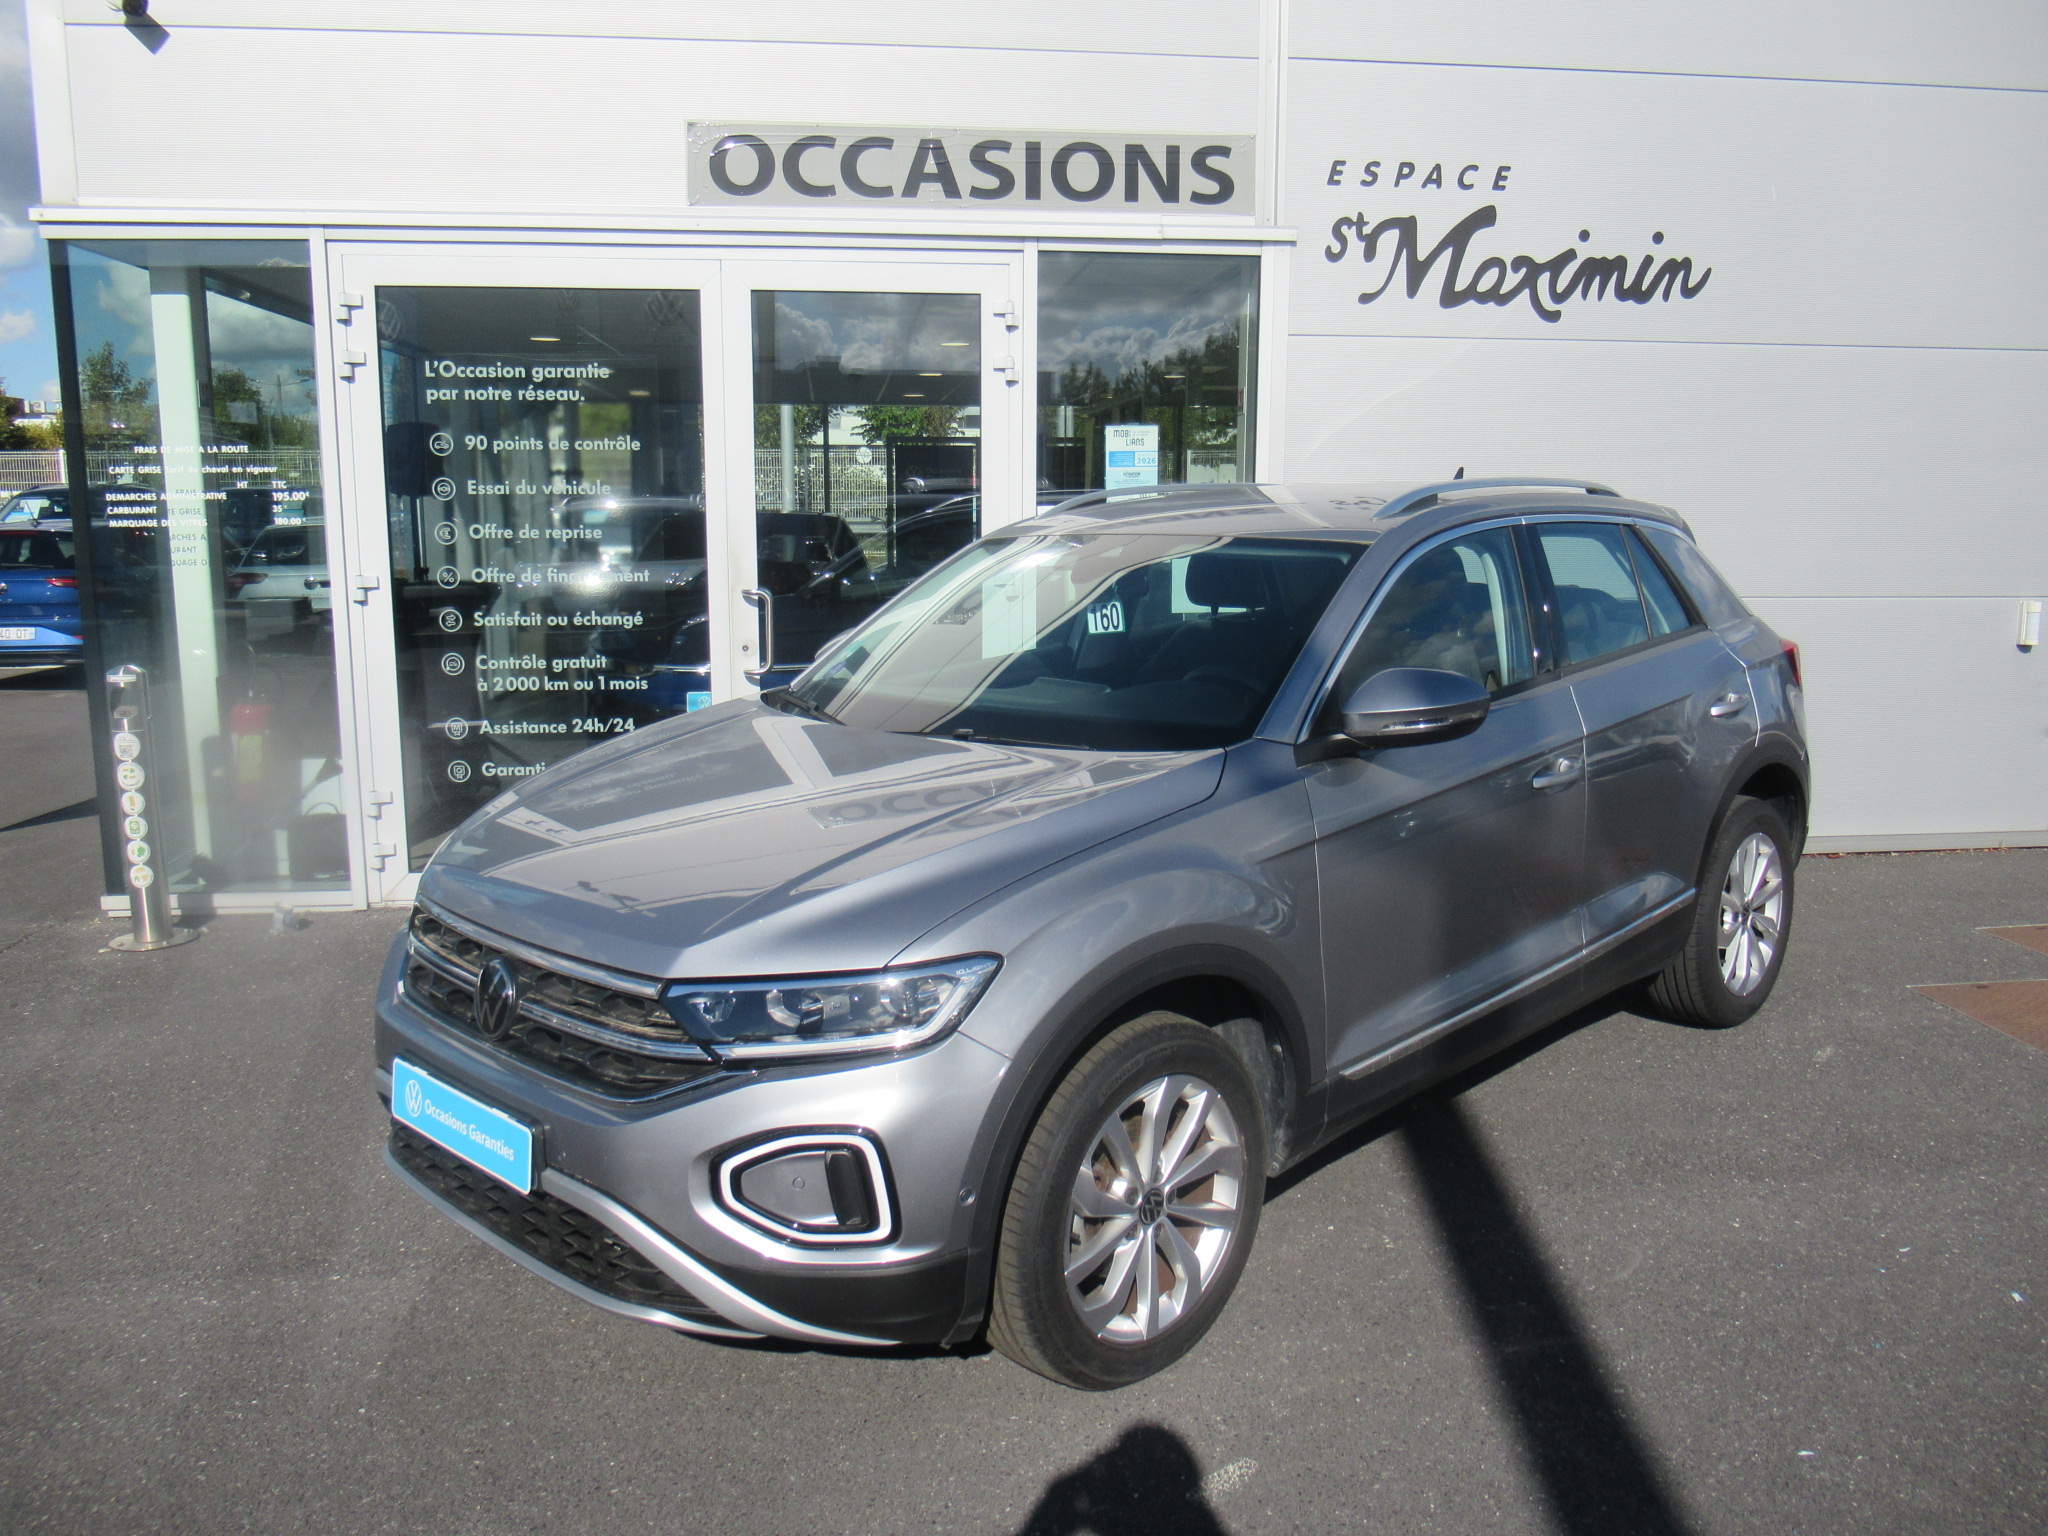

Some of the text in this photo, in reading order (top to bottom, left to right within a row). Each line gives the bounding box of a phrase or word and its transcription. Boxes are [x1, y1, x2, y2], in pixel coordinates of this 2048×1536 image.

[709, 133, 1236, 206] OCCASIONS
[1326, 159, 1512, 192] ESPACE
[1324, 204, 1712, 324] St Maximin
[531, 362, 610, 382] garantie
[426, 384, 585, 404] par notre réseau.
[134, 445, 250, 454] FRAIS DE MISE A LA ROUTE
[464, 435, 641, 454] 90 points de contrôle
[108, 465, 135, 475] CARTE
[137, 465, 162, 474] GRISE
[201, 464, 229, 473] cheval
[246, 464, 278, 475] vigueur
[1136, 457, 1157, 465] 2026
[237, 480, 287, 489] HT TTC
[467, 480, 510, 496] Essai
[515, 480, 537, 495] du
[105, 492, 157, 502] DEMARCHES
[160, 491, 227, 501] ADMINISTRATIVE
[107, 506, 157, 515] CARBURANT
[109, 519, 159, 528] MARQUAGE
[161, 519, 177, 528] DES
[180, 518, 208, 527] VITRES
[469, 523, 602, 542] Offre de reprise
[471, 567, 515, 584] Offre
[521, 567, 542, 583] de
[473, 610, 643, 629] Satisfait ou échangé
[1091, 603, 1120, 631] 160
[475, 654, 607, 673] Contrôle gratuit
[477, 677, 488, 691] à
[544, 676, 569, 691] km
[573, 680, 594, 691] ou
[598, 676, 605, 690] 1
[610, 676, 648, 691] mois
[479, 718, 635, 735] Assistance 24h/24
[425, 1099, 468, 1136] Occasions
[469, 1124, 515, 1161] Garanties
